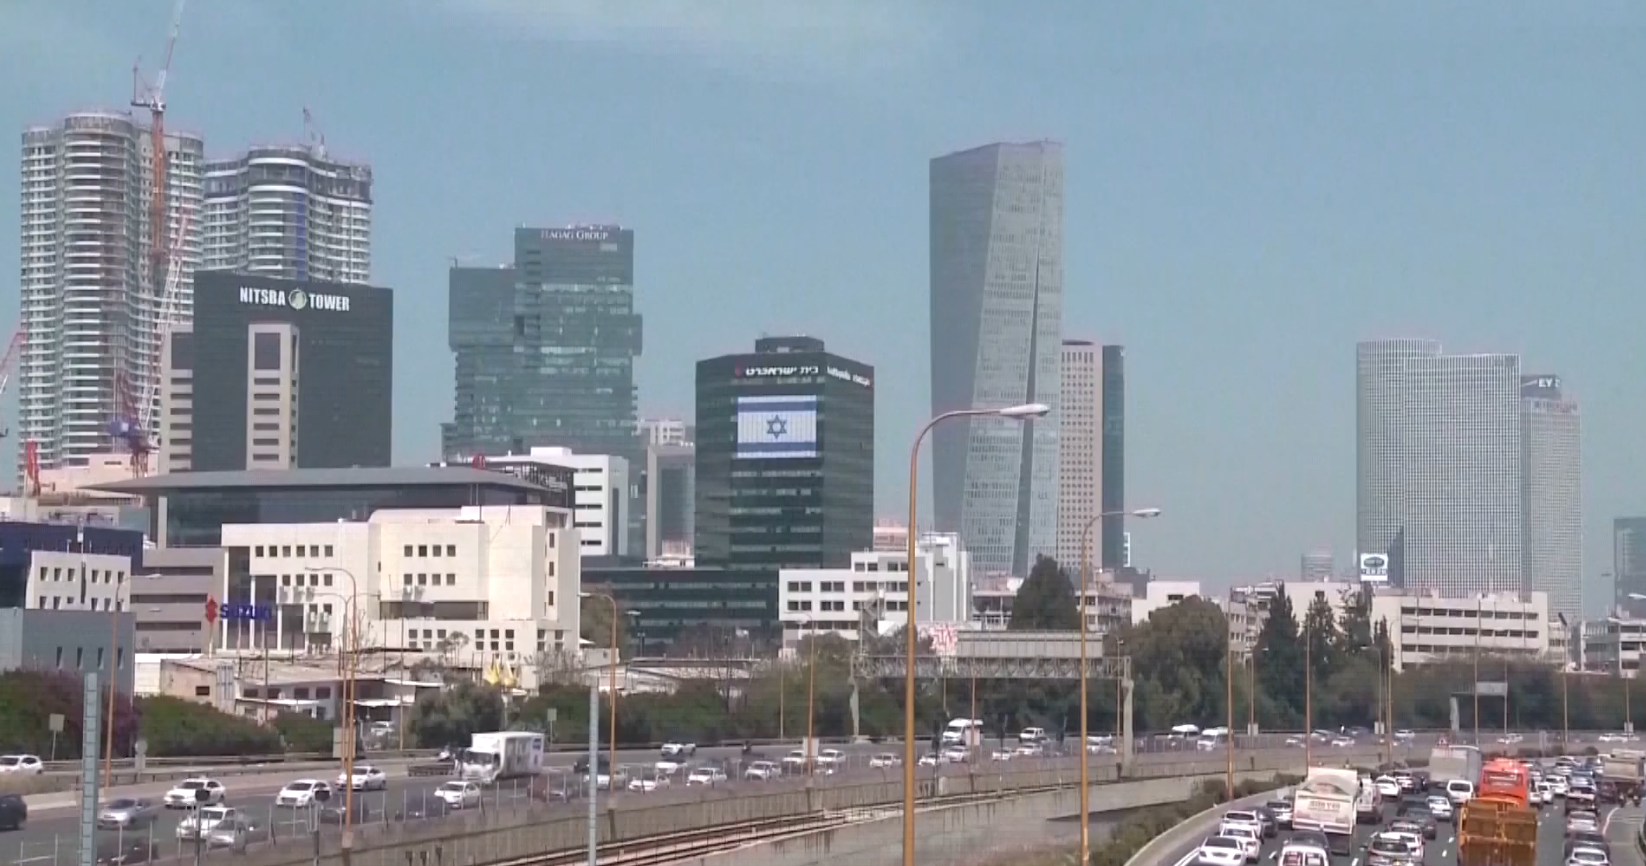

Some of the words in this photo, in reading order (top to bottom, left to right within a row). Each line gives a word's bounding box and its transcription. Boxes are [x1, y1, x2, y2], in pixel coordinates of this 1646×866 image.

[240, 287, 286, 306] NITSBA
[309, 292, 350, 311] TOWER
[745, 366, 798, 376] ישראכרט
[800, 365, 819, 375] בית
